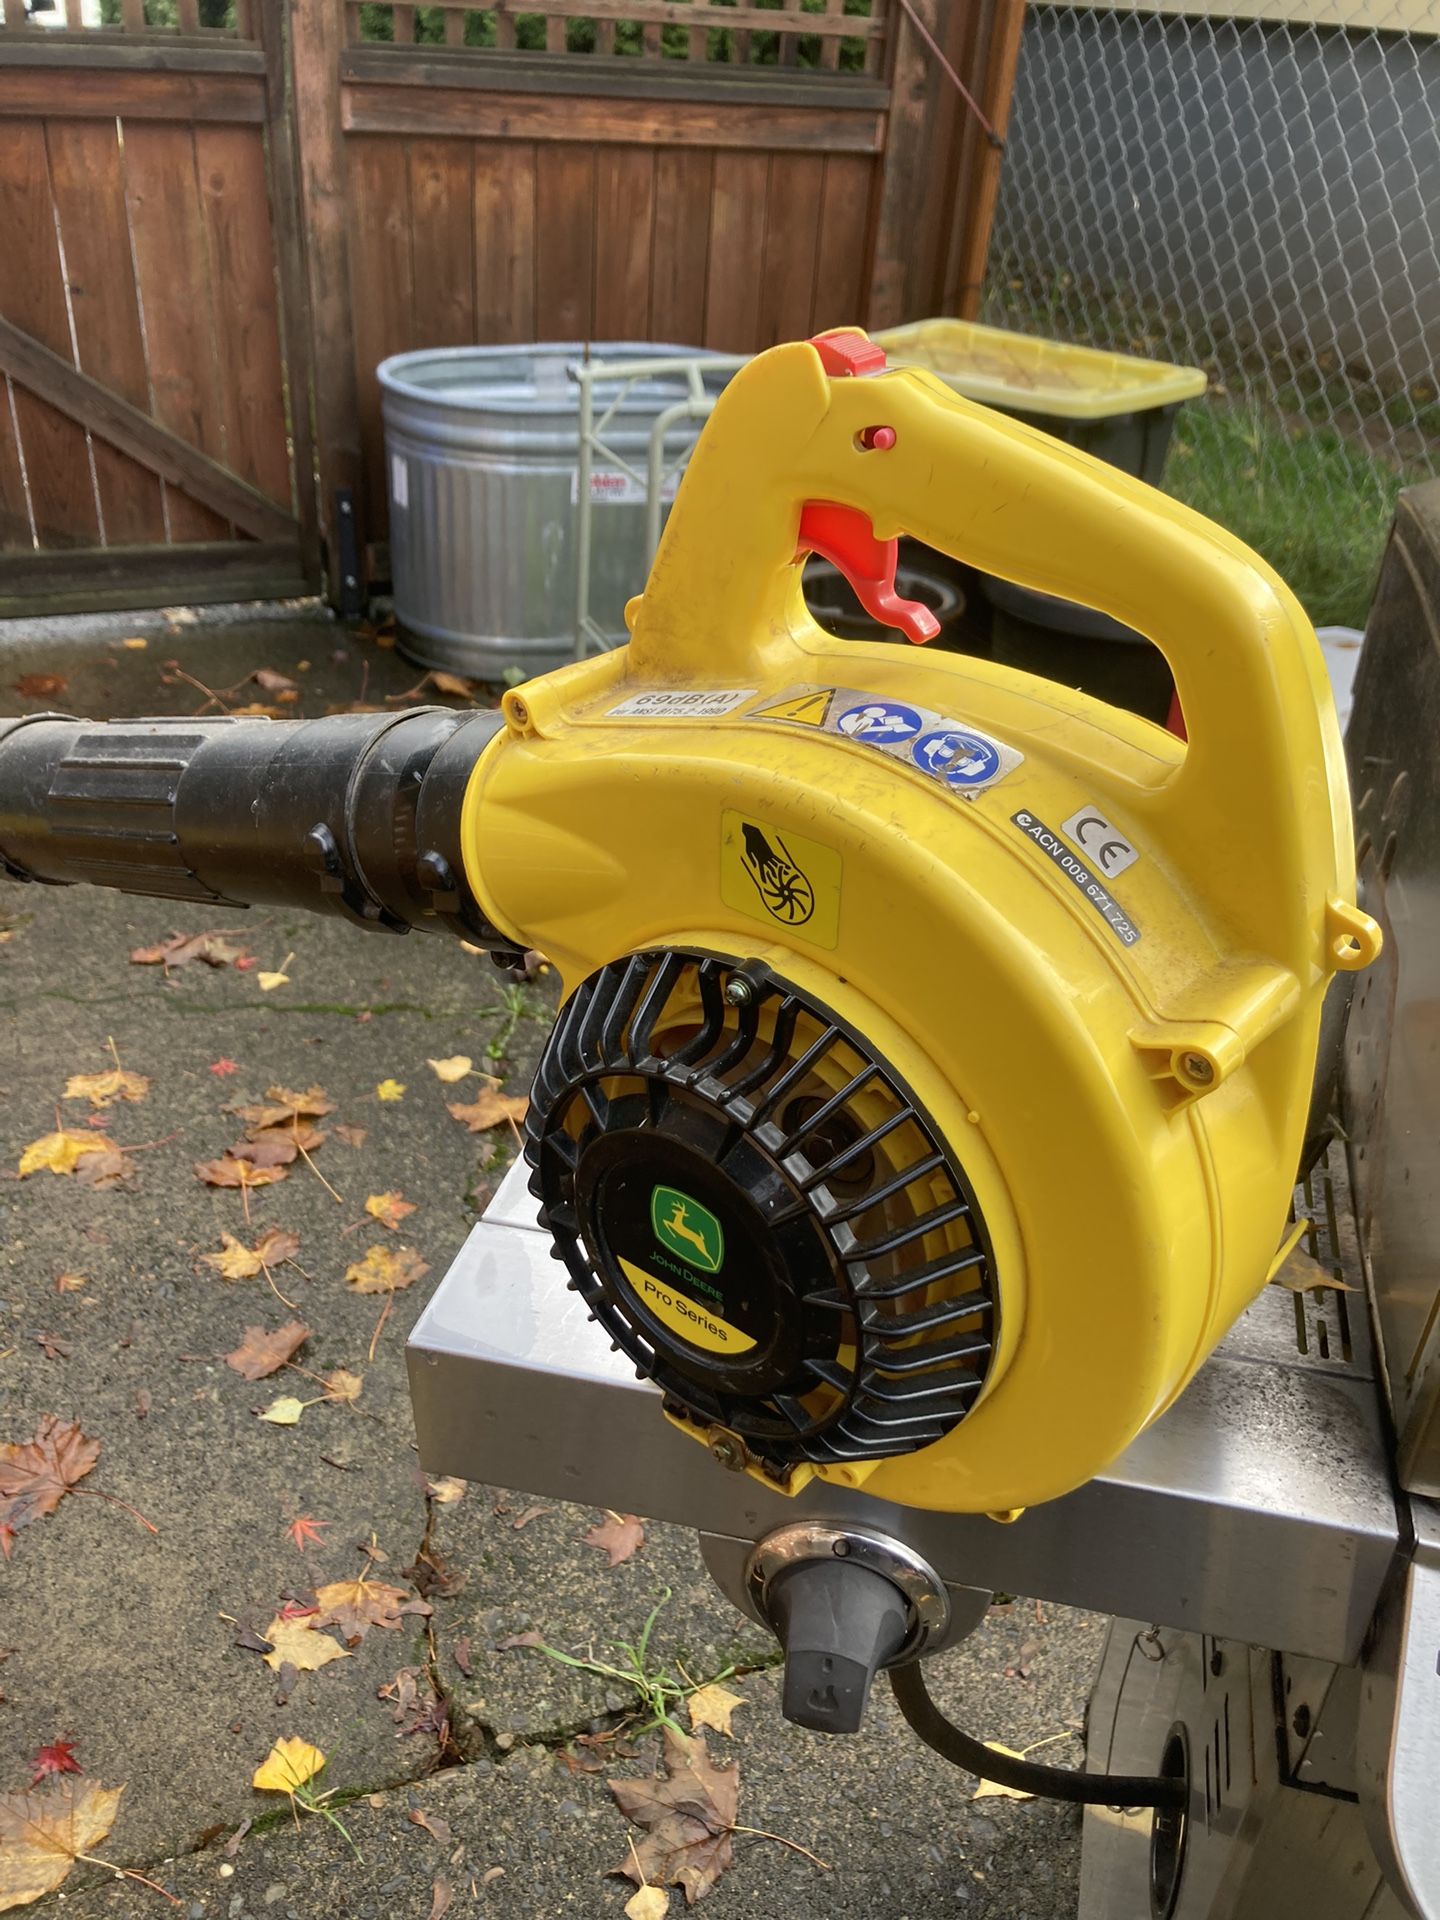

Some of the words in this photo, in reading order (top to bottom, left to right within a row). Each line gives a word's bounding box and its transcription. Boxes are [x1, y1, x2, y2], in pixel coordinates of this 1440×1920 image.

[636, 693, 739, 705] 69dB(A)
[1076, 817, 1131, 870] CE
[1029, 826, 1063, 857] ACN
[1061, 856, 1088, 884] 008
[1086, 884, 1113, 911] 671
[1111, 912, 1137, 943] 725
[649, 1250, 683, 1277] JOHN
[683, 1270, 725, 1302] DEERE
[644, 1279, 673, 1307] Pro
[676, 1301, 729, 1342] Series
